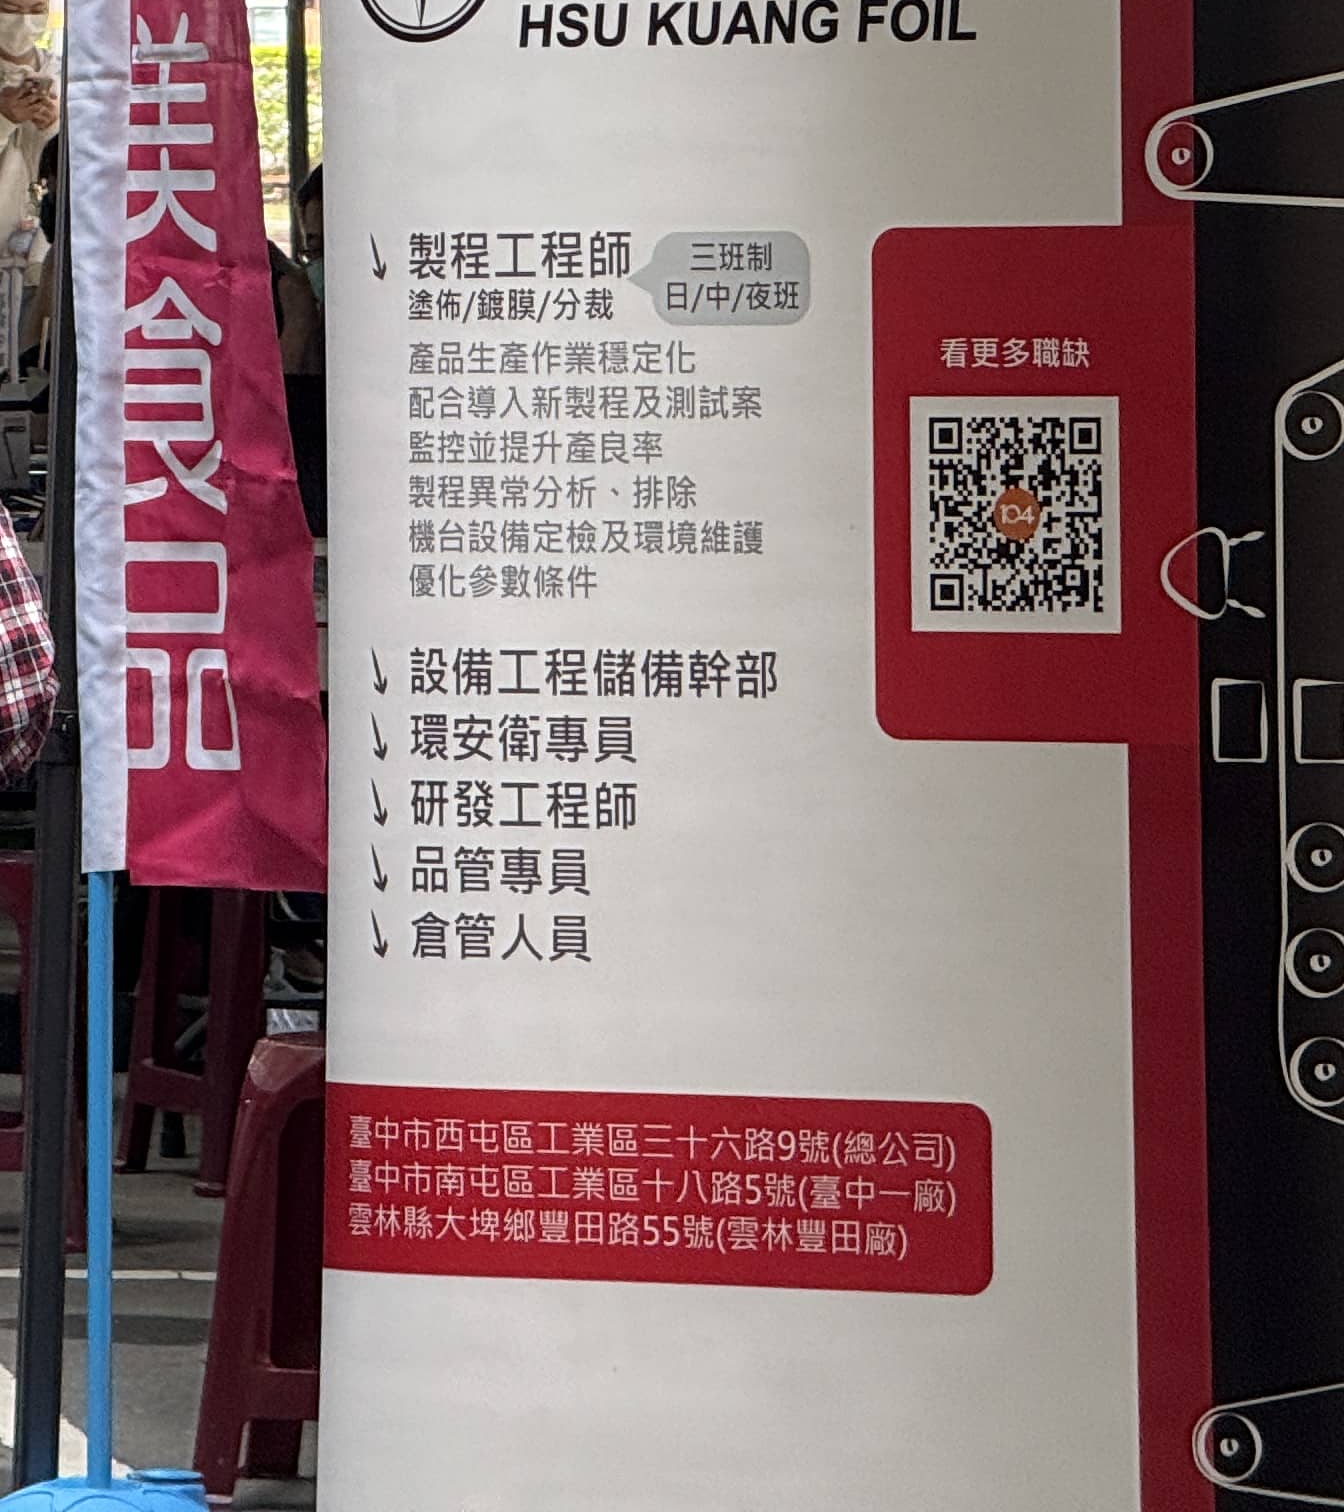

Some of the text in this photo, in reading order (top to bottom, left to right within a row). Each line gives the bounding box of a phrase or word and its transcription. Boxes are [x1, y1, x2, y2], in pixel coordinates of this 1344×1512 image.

[519, 2, 628, 48] HSU
[649, 0, 839, 46] KUANG
[408, 230, 632, 280] 製程工程師
[690, 241, 773, 273] 三班制
[408, 288, 614, 323] 塗佈/鍍膜/分裁
[665, 280, 801, 313] 日/中/夜班
[408, 341, 696, 375] 產品生產作業穩定化
[939, 337, 1092, 368] 看更多職缺
[408, 385, 762, 420] 配合導入新製程及測試案
[408, 430, 663, 465] 監控並提升產良率
[408, 475, 697, 510] 製程異常分析、排除
[408, 520, 764, 556] 機台設備定檢及環境維護
[408, 564, 598, 599] 優化參數條件
[410, 648, 778, 698] 設備工程儲備幹部
[410, 714, 637, 764] 環安衛專員
[410, 780, 637, 830] 研發工程師
[411, 846, 590, 895] 品管專員
[411, 912, 592, 963] 倉管人員
[349, 1114, 956, 1172] 臺中市西屯區工業區三十六路9號(總公司)
[349, 1159, 957, 1219] 臺中市南屯區工業區十八路5號(臺中一廠)
[349, 1203, 908, 1261] 雲林縣大埤鄉豐田路55號(雲林豐田廠)
